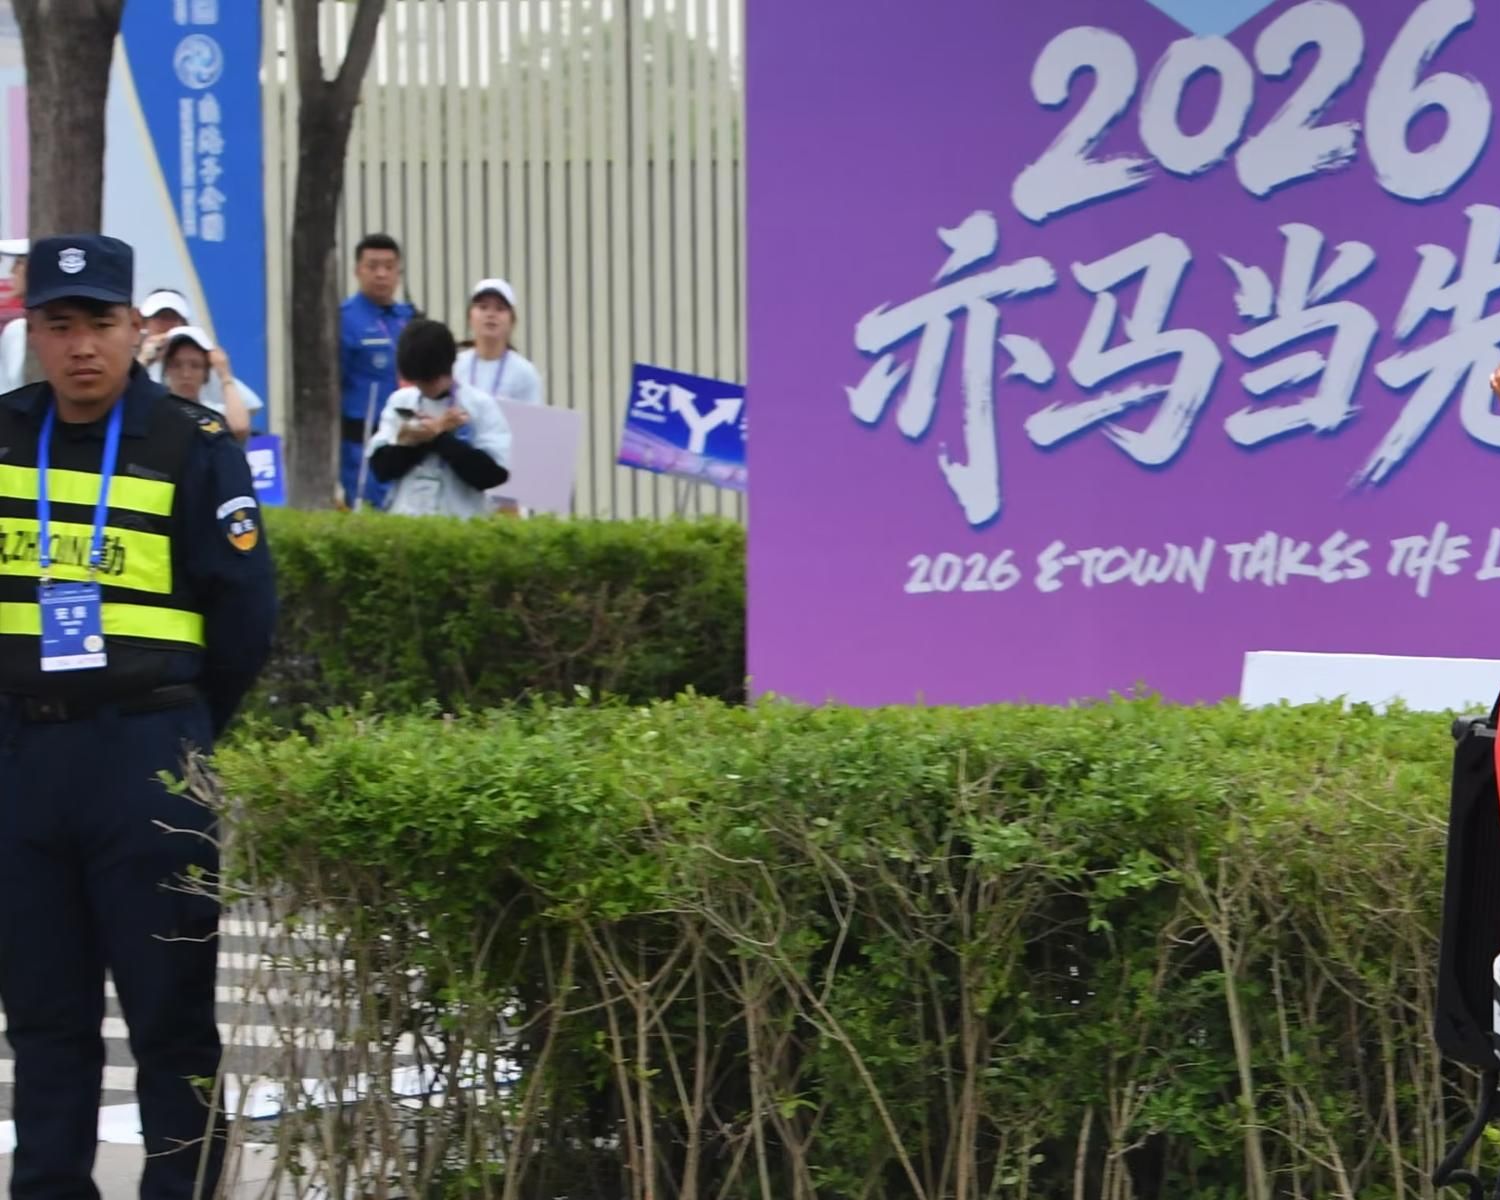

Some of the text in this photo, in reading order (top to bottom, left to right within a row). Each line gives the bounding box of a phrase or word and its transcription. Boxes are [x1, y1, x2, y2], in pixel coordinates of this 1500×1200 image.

[1012, 0, 1493, 222] 2026
[634, 379, 668, 412] 女
[904, 549, 1021, 594] 2026
[1035, 537, 1213, 593] E-TOWN
[1225, 531, 1370, 586] TAKES
[1387, 522, 1472, 597] THE
